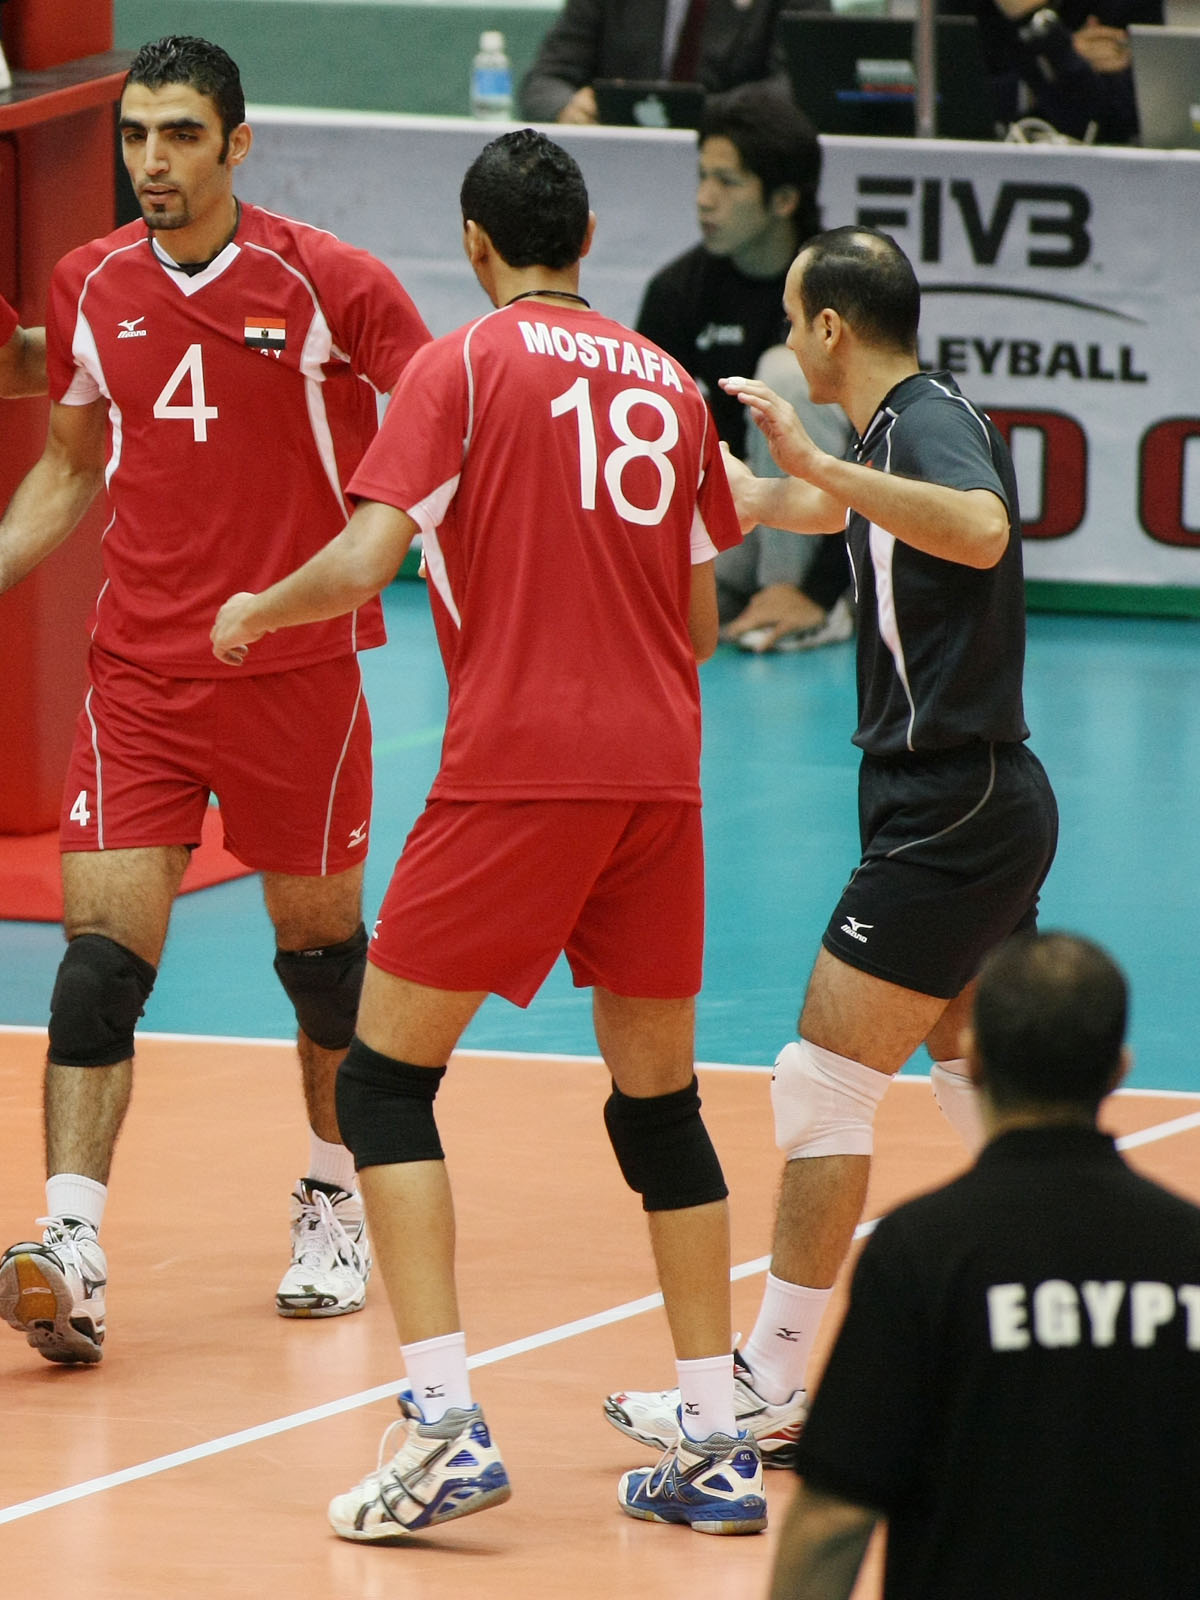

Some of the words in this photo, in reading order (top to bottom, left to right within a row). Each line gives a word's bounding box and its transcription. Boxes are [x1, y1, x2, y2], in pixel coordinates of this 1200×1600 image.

[857, 176, 1092, 268] FIVB
[152, 343, 219, 442] 4
[518, 321, 683, 393] MOSTAFA
[550, 376, 679, 526] 18
[69, 790, 91, 827] 4
[986, 1279, 1200, 1352] EGYPT
